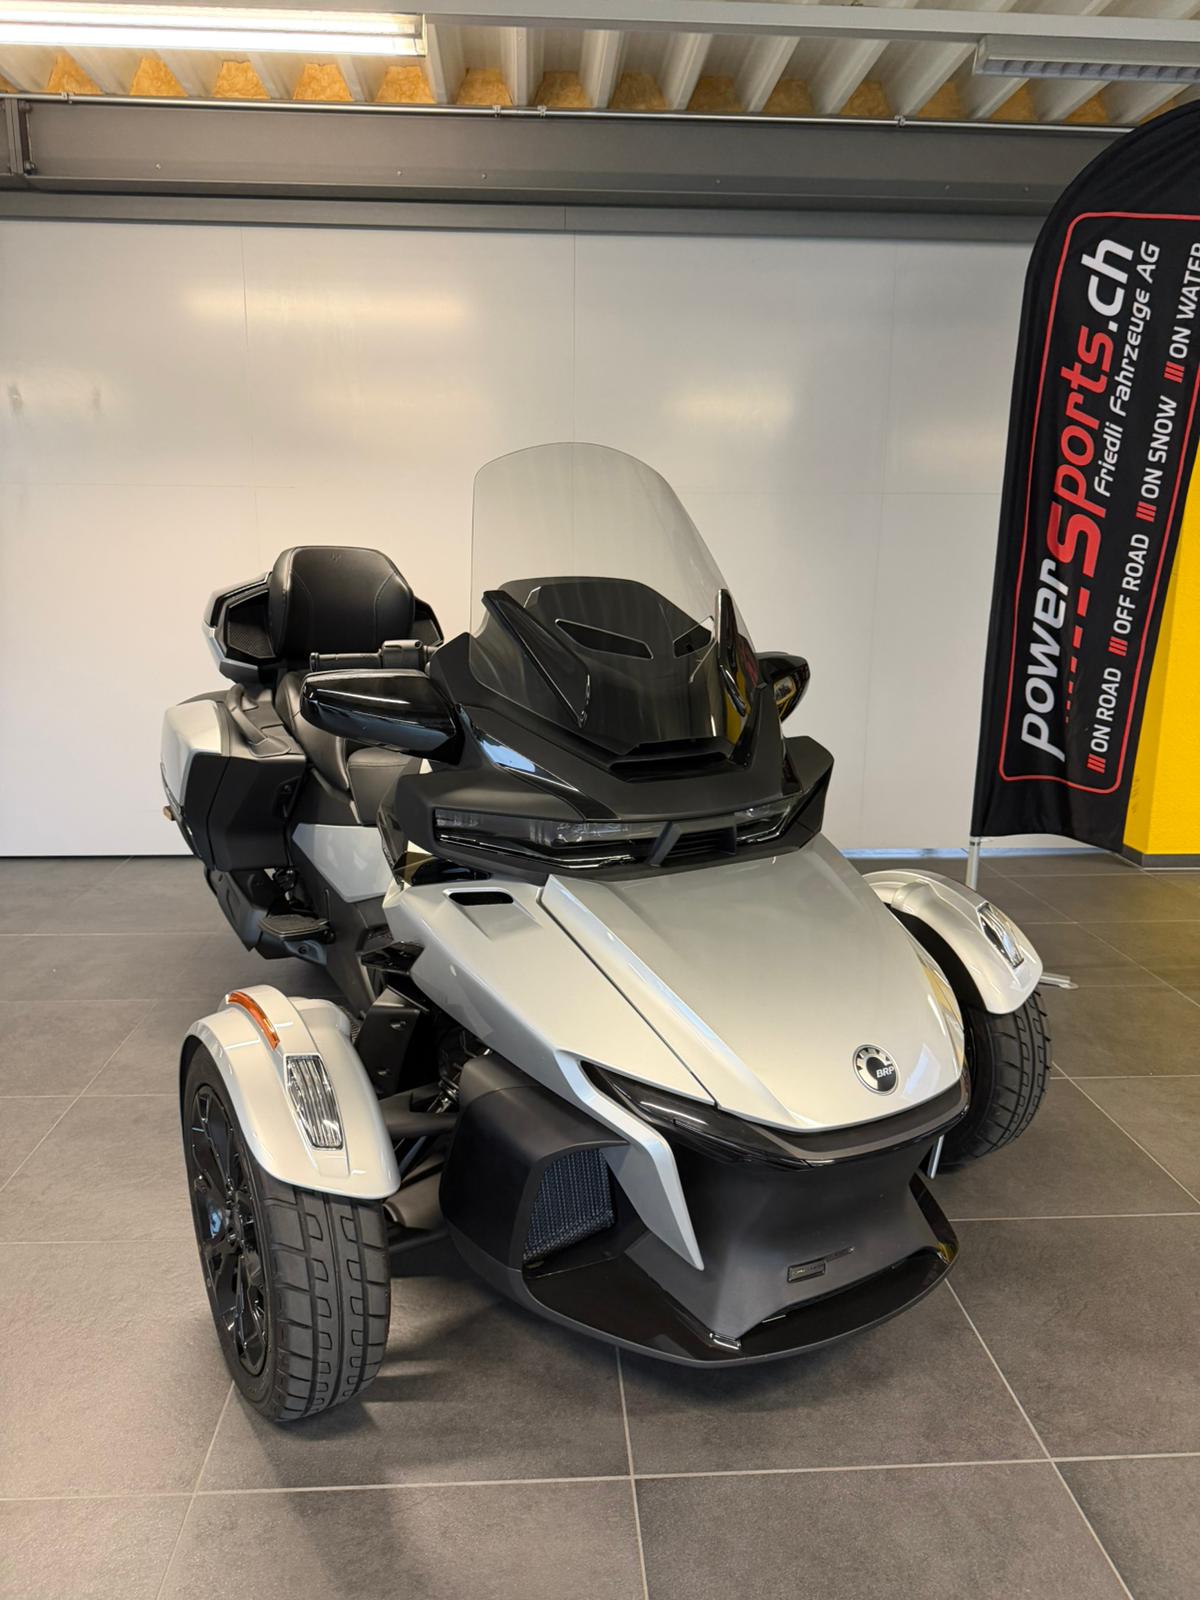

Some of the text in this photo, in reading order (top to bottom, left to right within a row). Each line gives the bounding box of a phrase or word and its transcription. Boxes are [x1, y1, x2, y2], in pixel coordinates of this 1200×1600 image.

[1168, 326, 1192, 359] ON
[1093, 240, 1161, 498] Friedli Fahrzeuge AG
[1147, 394, 1178, 464] SNOW
[1021, 239, 1135, 762] powerSports.ch
[1140, 467, 1164, 499] ON
[1121, 533, 1150, 592] ROAD
[1113, 594, 1136, 635] OFF
[1095, 667, 1122, 722] ROAD
[1090, 723, 1112, 753] ON
[876, 1066, 895, 1078] BRP
